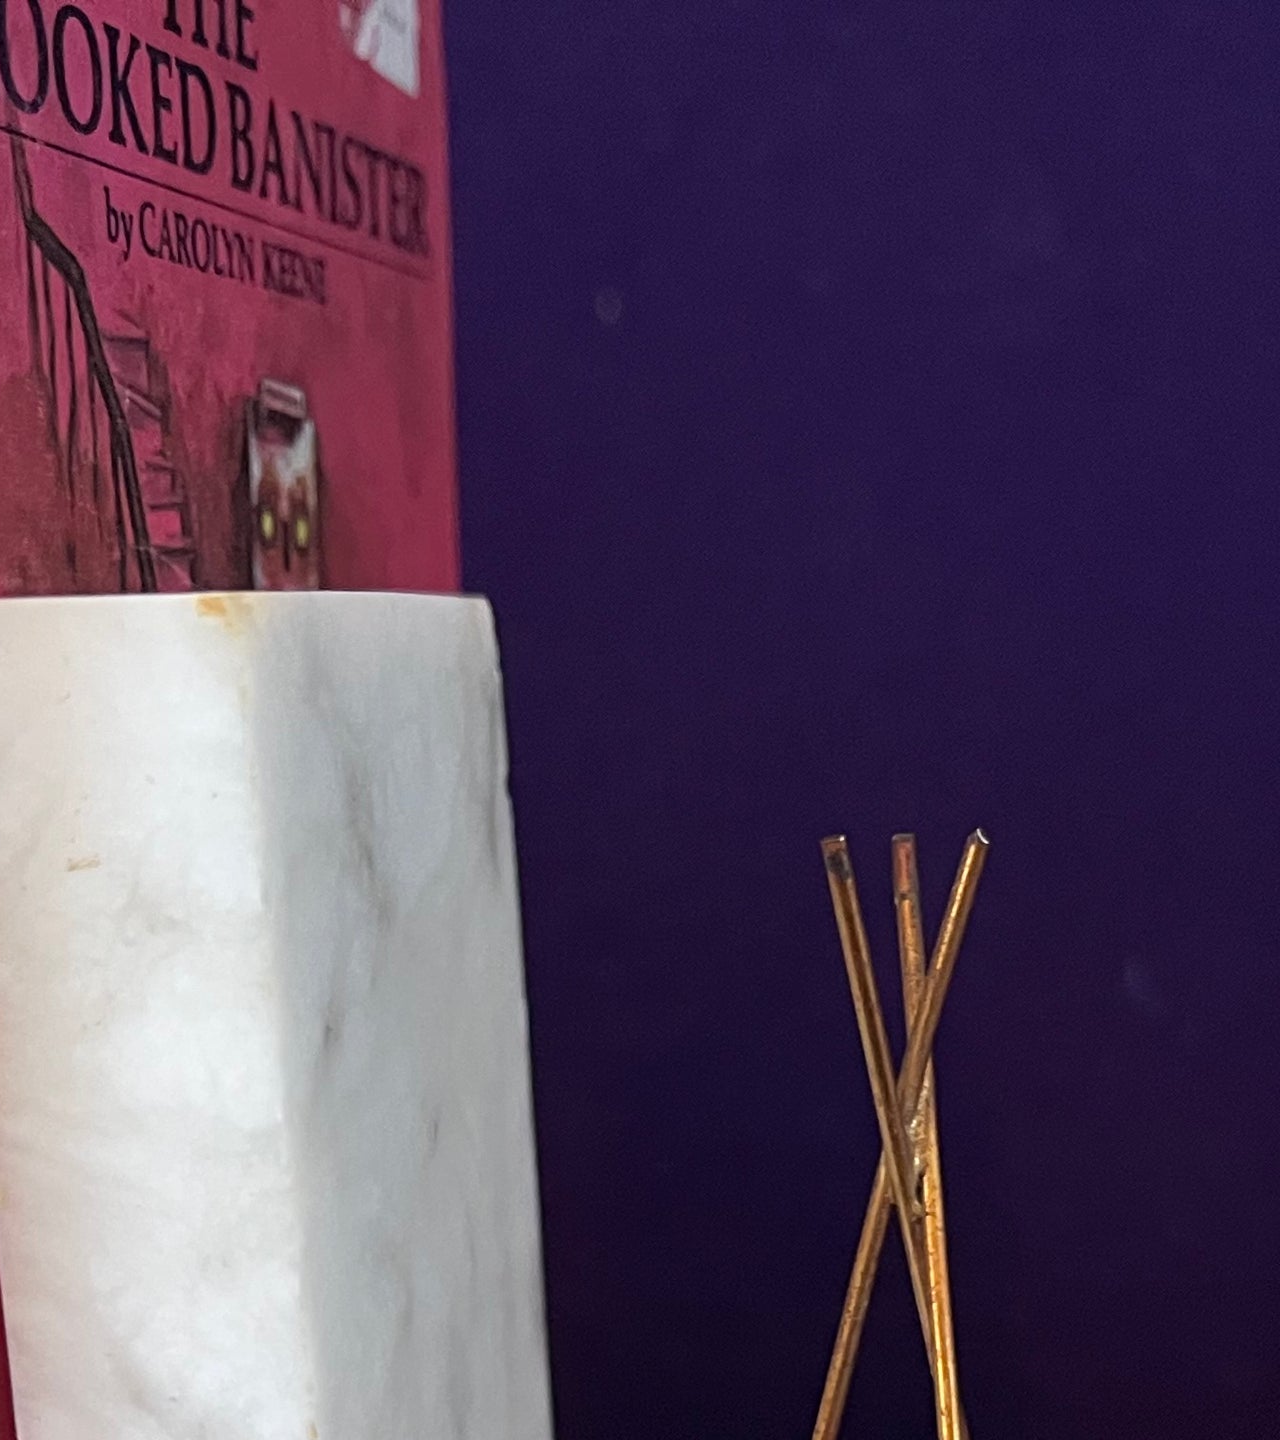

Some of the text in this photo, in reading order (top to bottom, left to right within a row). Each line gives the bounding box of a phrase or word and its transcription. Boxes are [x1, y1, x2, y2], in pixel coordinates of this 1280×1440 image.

[104, 185, 133, 262] by
[139, 201, 256, 282] CAROLYN
[225, 80, 431, 256] BANISTER
